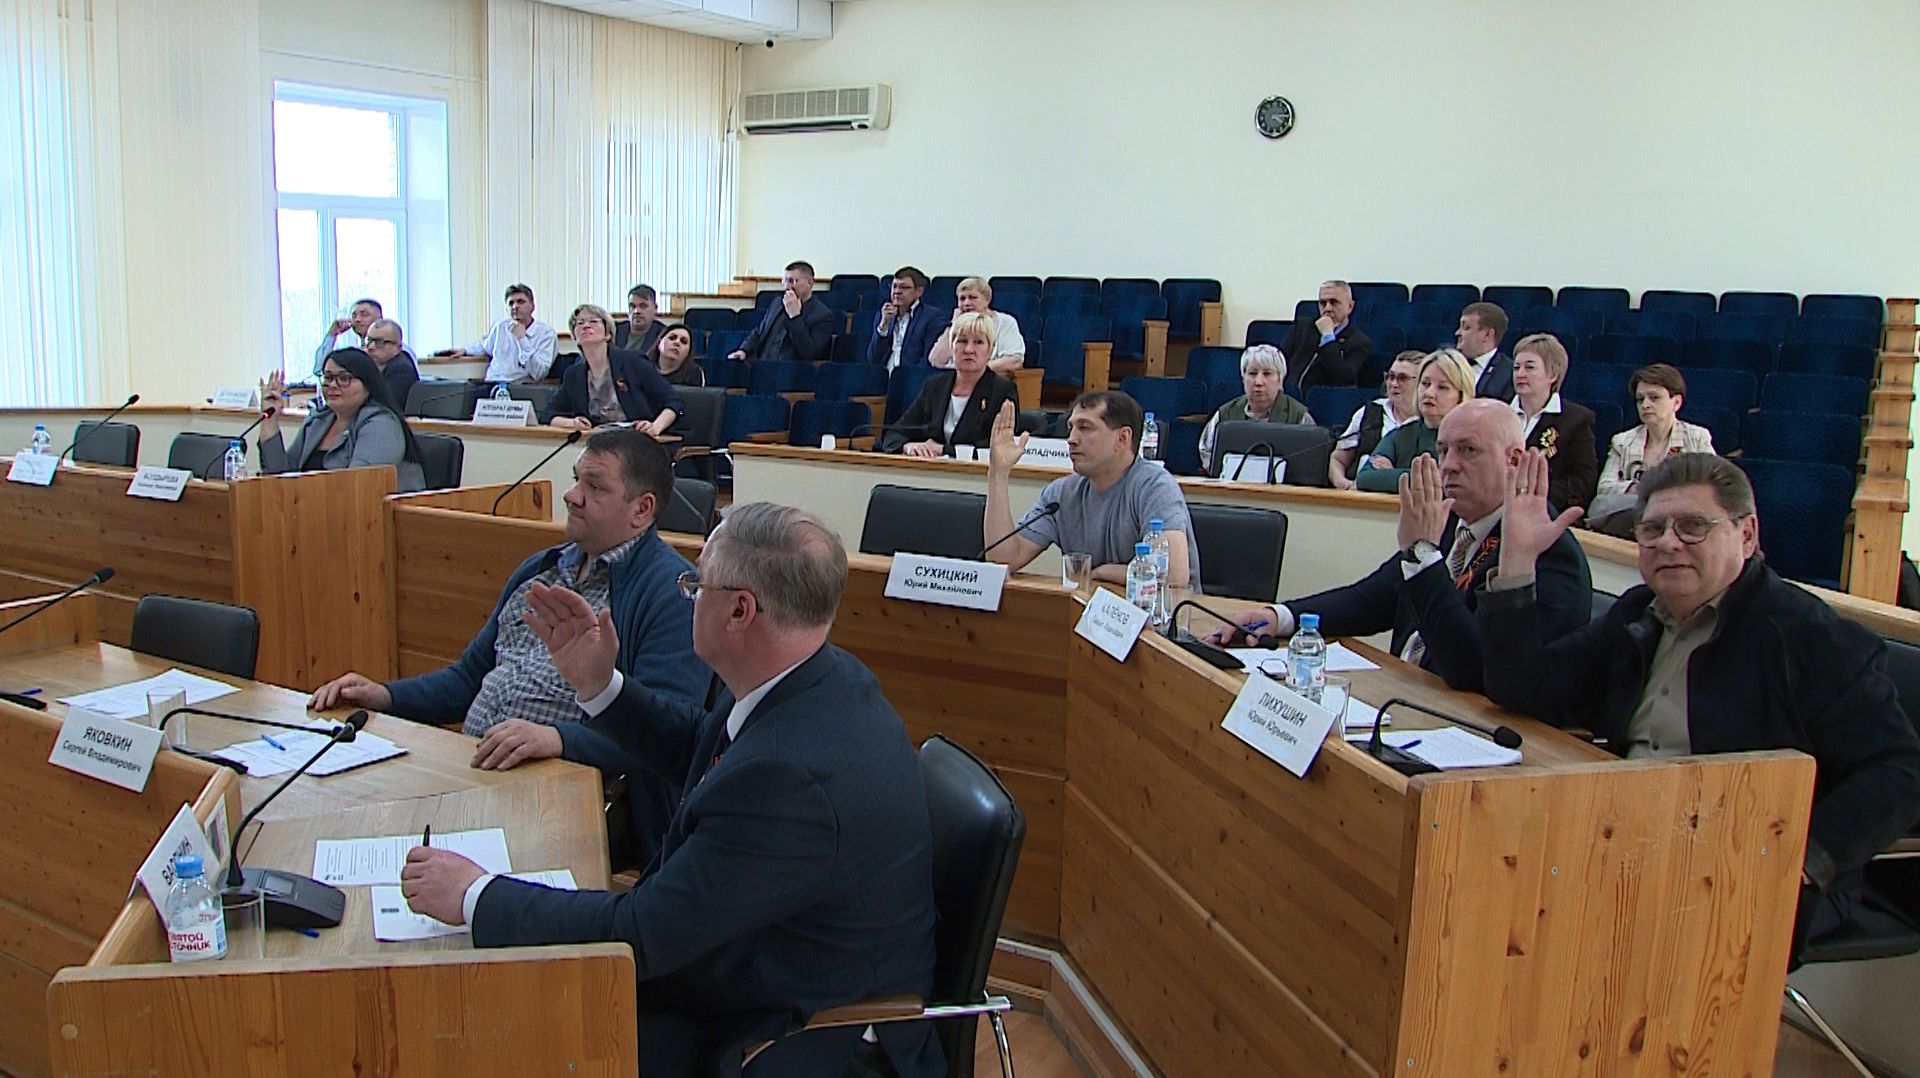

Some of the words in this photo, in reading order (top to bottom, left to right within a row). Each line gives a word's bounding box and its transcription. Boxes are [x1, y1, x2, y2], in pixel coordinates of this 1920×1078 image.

[904, 578, 928, 589] Юрий
[929, 582, 983, 597] Михайлович
[914, 565, 979, 584] СУХИЦКИЙ
[1258, 691, 1308, 727] ЛИХУШИН
[83, 725, 133, 753] ЯКОВКИН
[1265, 719, 1298, 747] Юрьевич
[62, 739, 87, 755] Сергей
[87, 747, 142, 773] Владимирович
